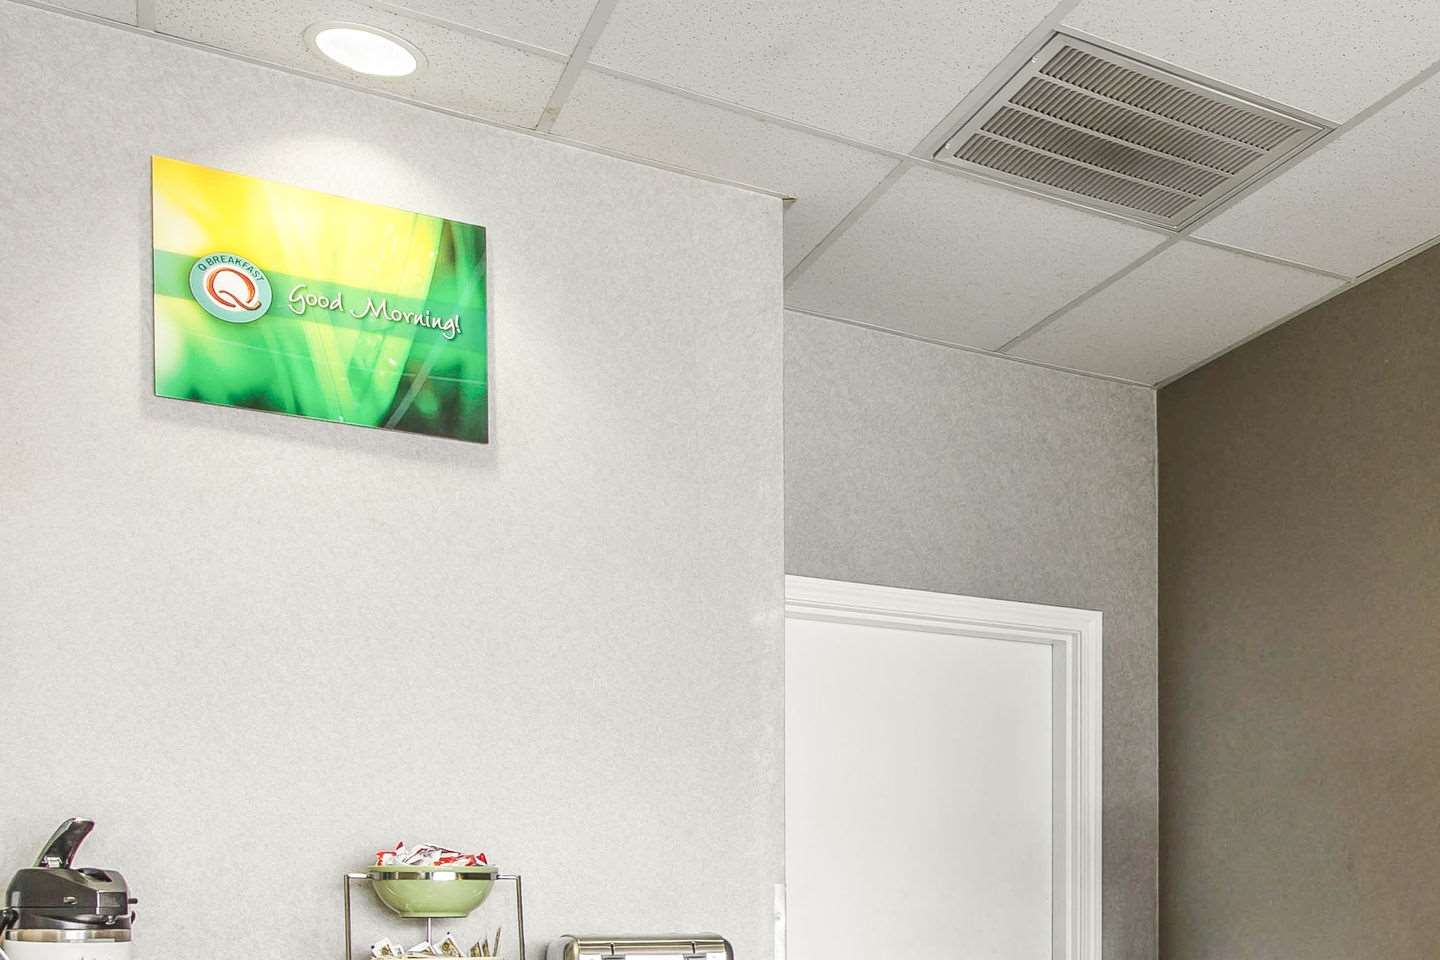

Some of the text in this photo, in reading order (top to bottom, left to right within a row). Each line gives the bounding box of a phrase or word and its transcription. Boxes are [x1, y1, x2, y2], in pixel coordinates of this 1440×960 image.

[207, 255, 266, 282] BREAKFAST
[287, 284, 462, 341] Good Morning!
